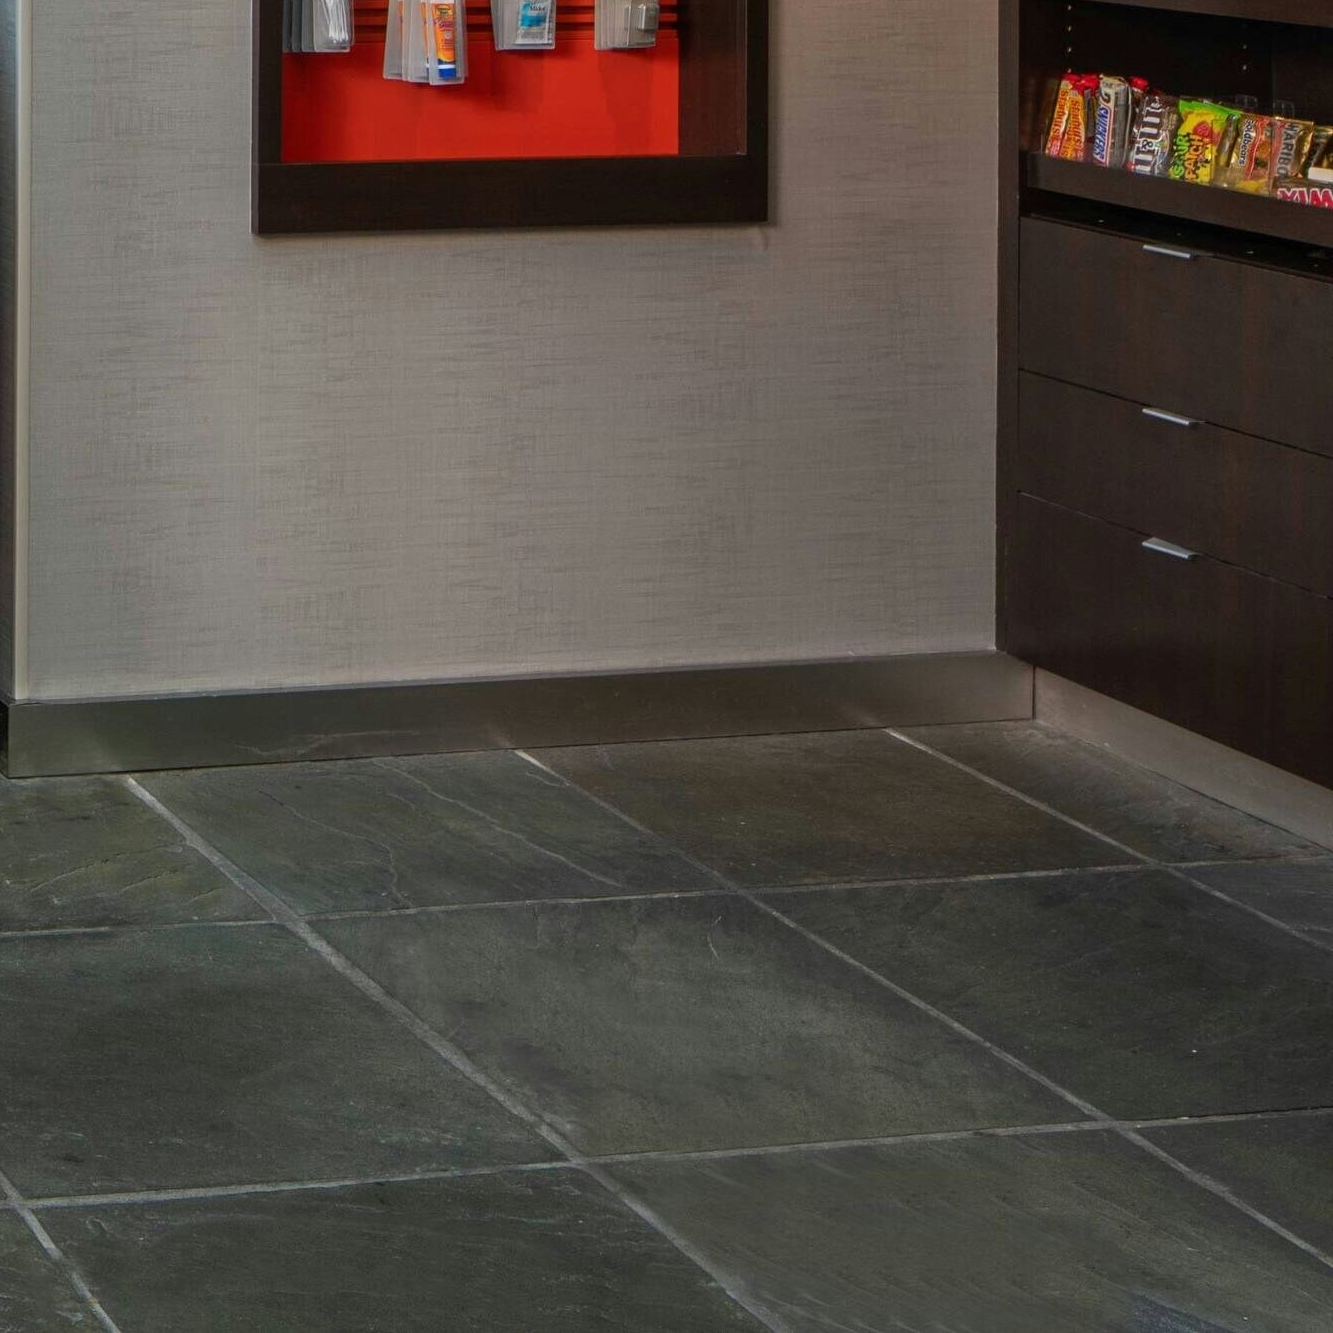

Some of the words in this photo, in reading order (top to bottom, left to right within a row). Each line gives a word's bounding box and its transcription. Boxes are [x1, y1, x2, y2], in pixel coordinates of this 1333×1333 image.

[1094, 106, 1109, 160] SNICKERS
[1173, 133, 1190, 178] SOUR
[1185, 134, 1204, 180] PATCH
[1277, 122, 1299, 180] HARIBO
